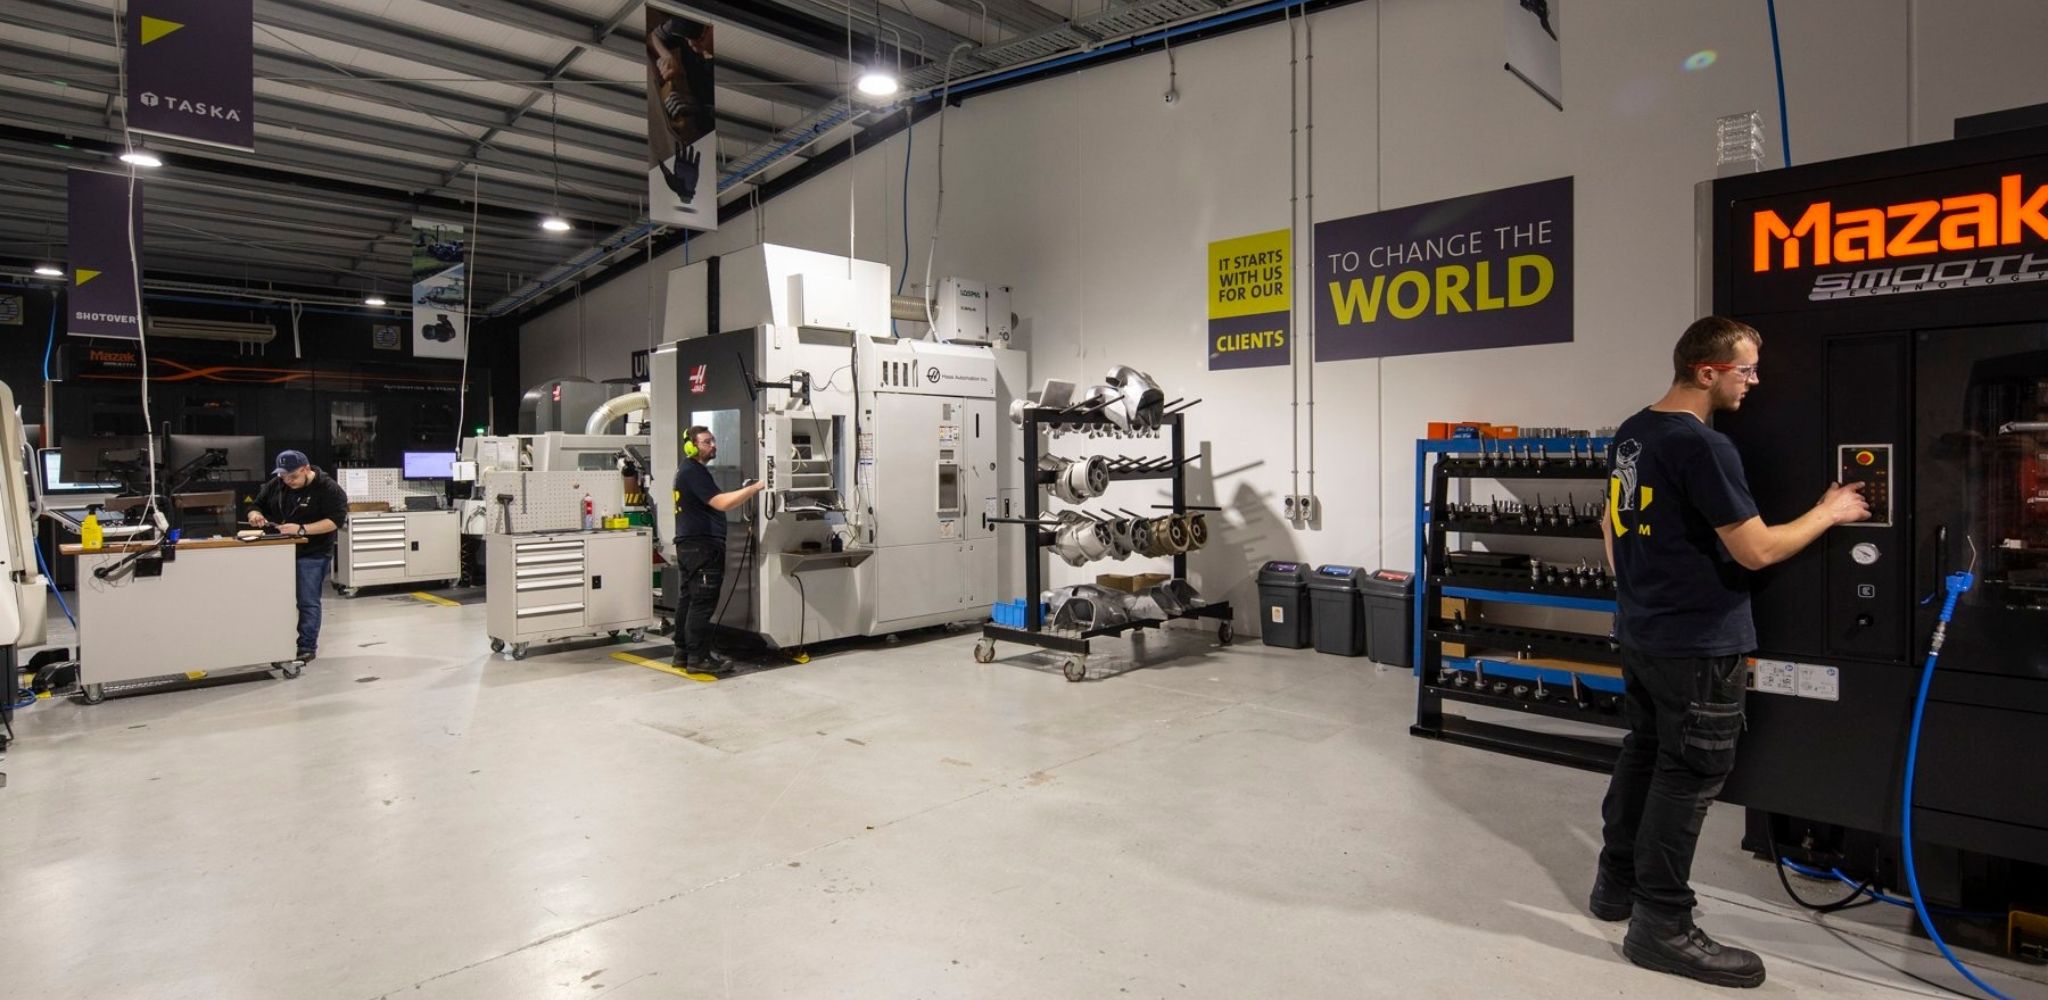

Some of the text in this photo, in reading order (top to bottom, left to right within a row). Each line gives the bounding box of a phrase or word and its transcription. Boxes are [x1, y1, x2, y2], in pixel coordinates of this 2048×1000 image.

[164, 96, 241, 122] TASKA
[1754, 174, 2048, 272] Mazak
[1328, 220, 1552, 274] TO CHANGE THE
[1218, 249, 1283, 271] IT STARTS
[1219, 266, 1283, 287] WITH US
[1829, 272, 2046, 298] TECHNOLOGY
[1218, 281, 1284, 303] FOR OUR
[1329, 254, 1555, 326] WORLD
[75, 311, 136, 324] SHOTOVER
[1216, 330, 1285, 352] CLIENTS
[90, 350, 135, 362] Mazak
[1638, 523, 1651, 536] M
